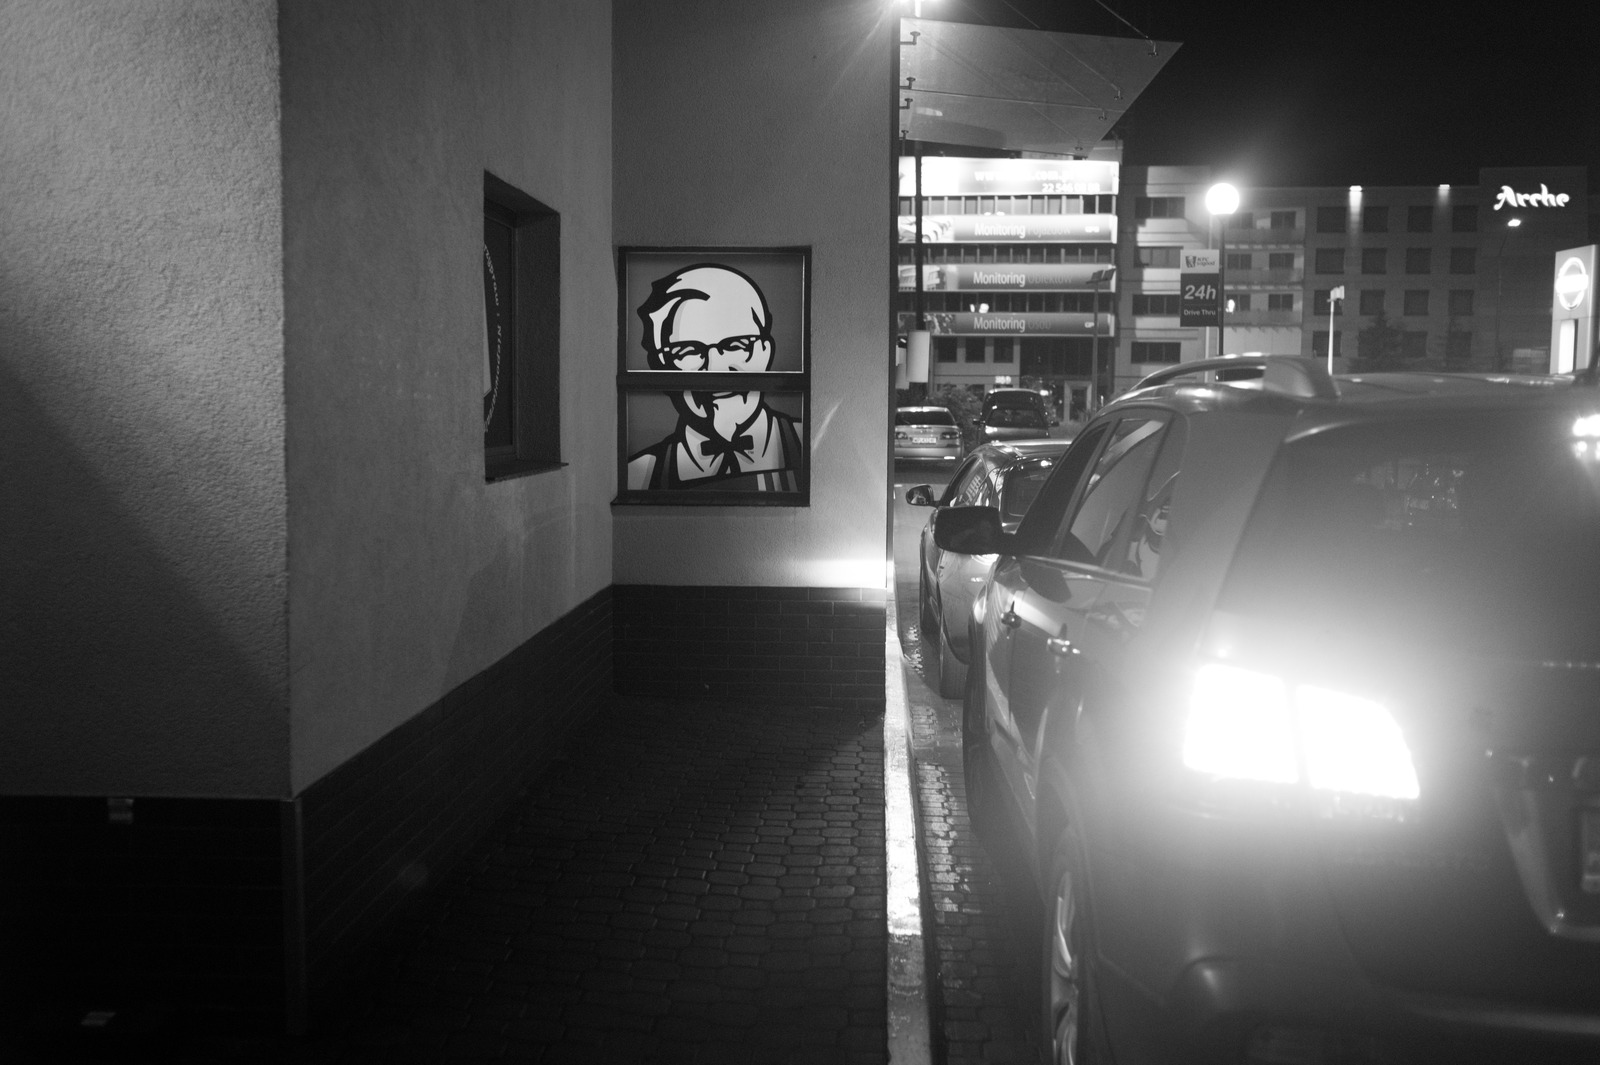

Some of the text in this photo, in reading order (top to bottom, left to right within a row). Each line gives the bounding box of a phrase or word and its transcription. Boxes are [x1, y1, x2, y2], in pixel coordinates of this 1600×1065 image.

[974, 222, 1026, 239] Monitoring
[973, 271, 1026, 288] Monitoring
[1184, 284, 1217, 300] 24h
[973, 316, 1026, 333] Monitoring
